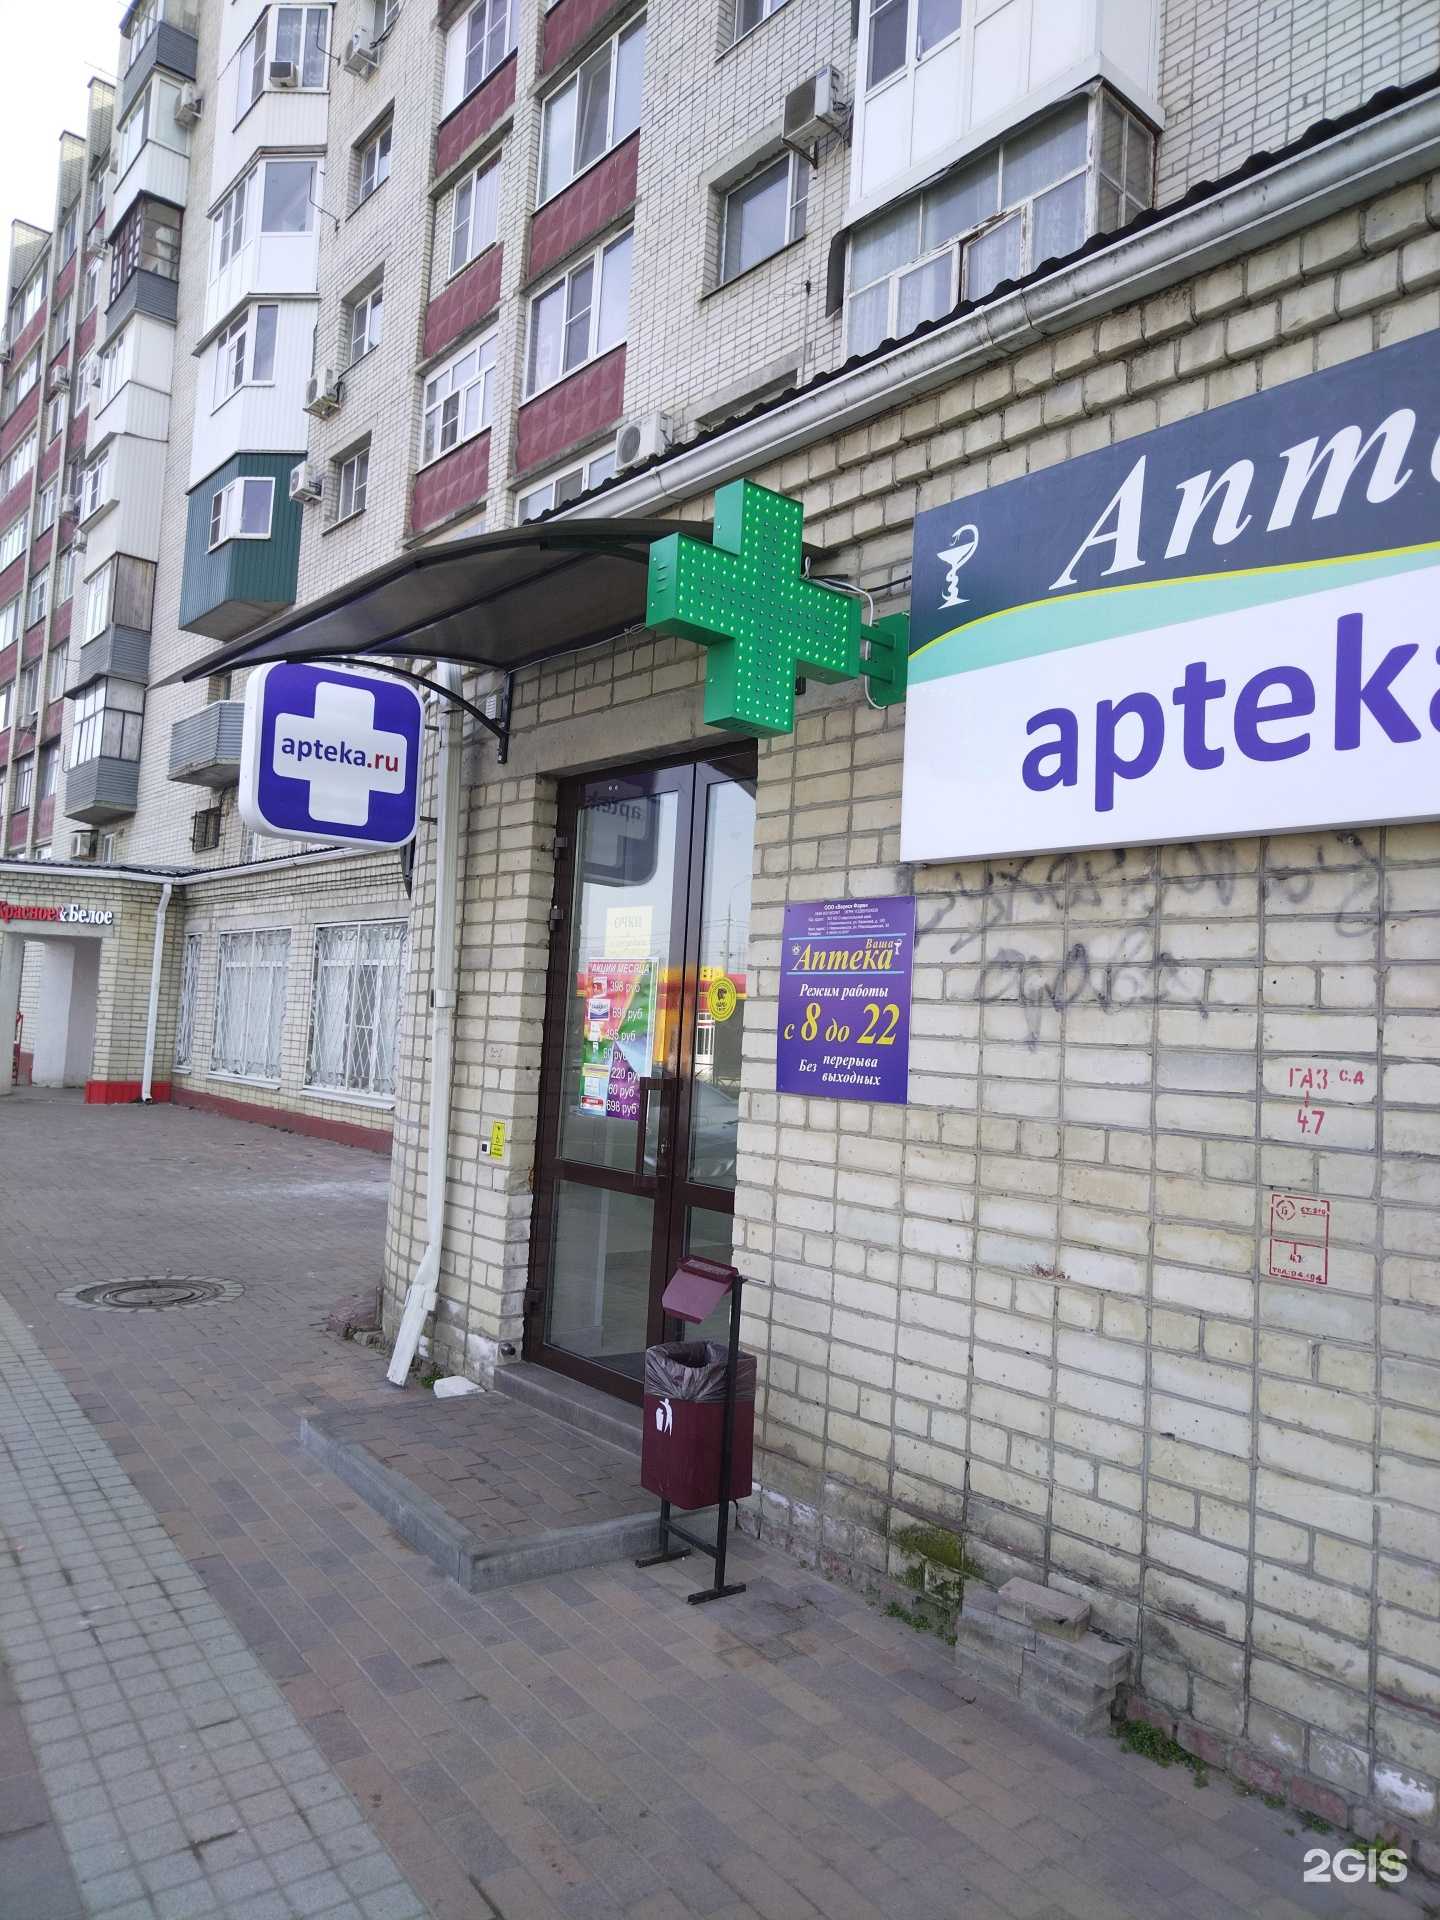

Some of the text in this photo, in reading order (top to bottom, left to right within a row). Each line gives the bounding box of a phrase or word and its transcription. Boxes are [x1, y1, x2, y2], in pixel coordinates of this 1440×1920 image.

[1049, 408, 1440, 591] Апт
[1022, 612, 1440, 812] aptek
[282, 737, 399, 773] apteka.ru
[865, 938, 894, 950] Ваша
[792, 943, 893, 971] Аптека
[617, 963, 650, 976] МЕСЯЦА
[799, 983, 889, 1001] Режим работы
[627, 1008, 643, 1022] руб
[783, 1002, 901, 1046] с 8 до 22
[611, 1067, 626, 1079] 220
[799, 1055, 879, 1073] Без перерыва
[822, 1071, 882, 1086] выходных
[1288, 1067, 1329, 1090] ГАЗ
[608, 1083, 635, 1099] 60 руб
[606, 1099, 621, 1113] 698
